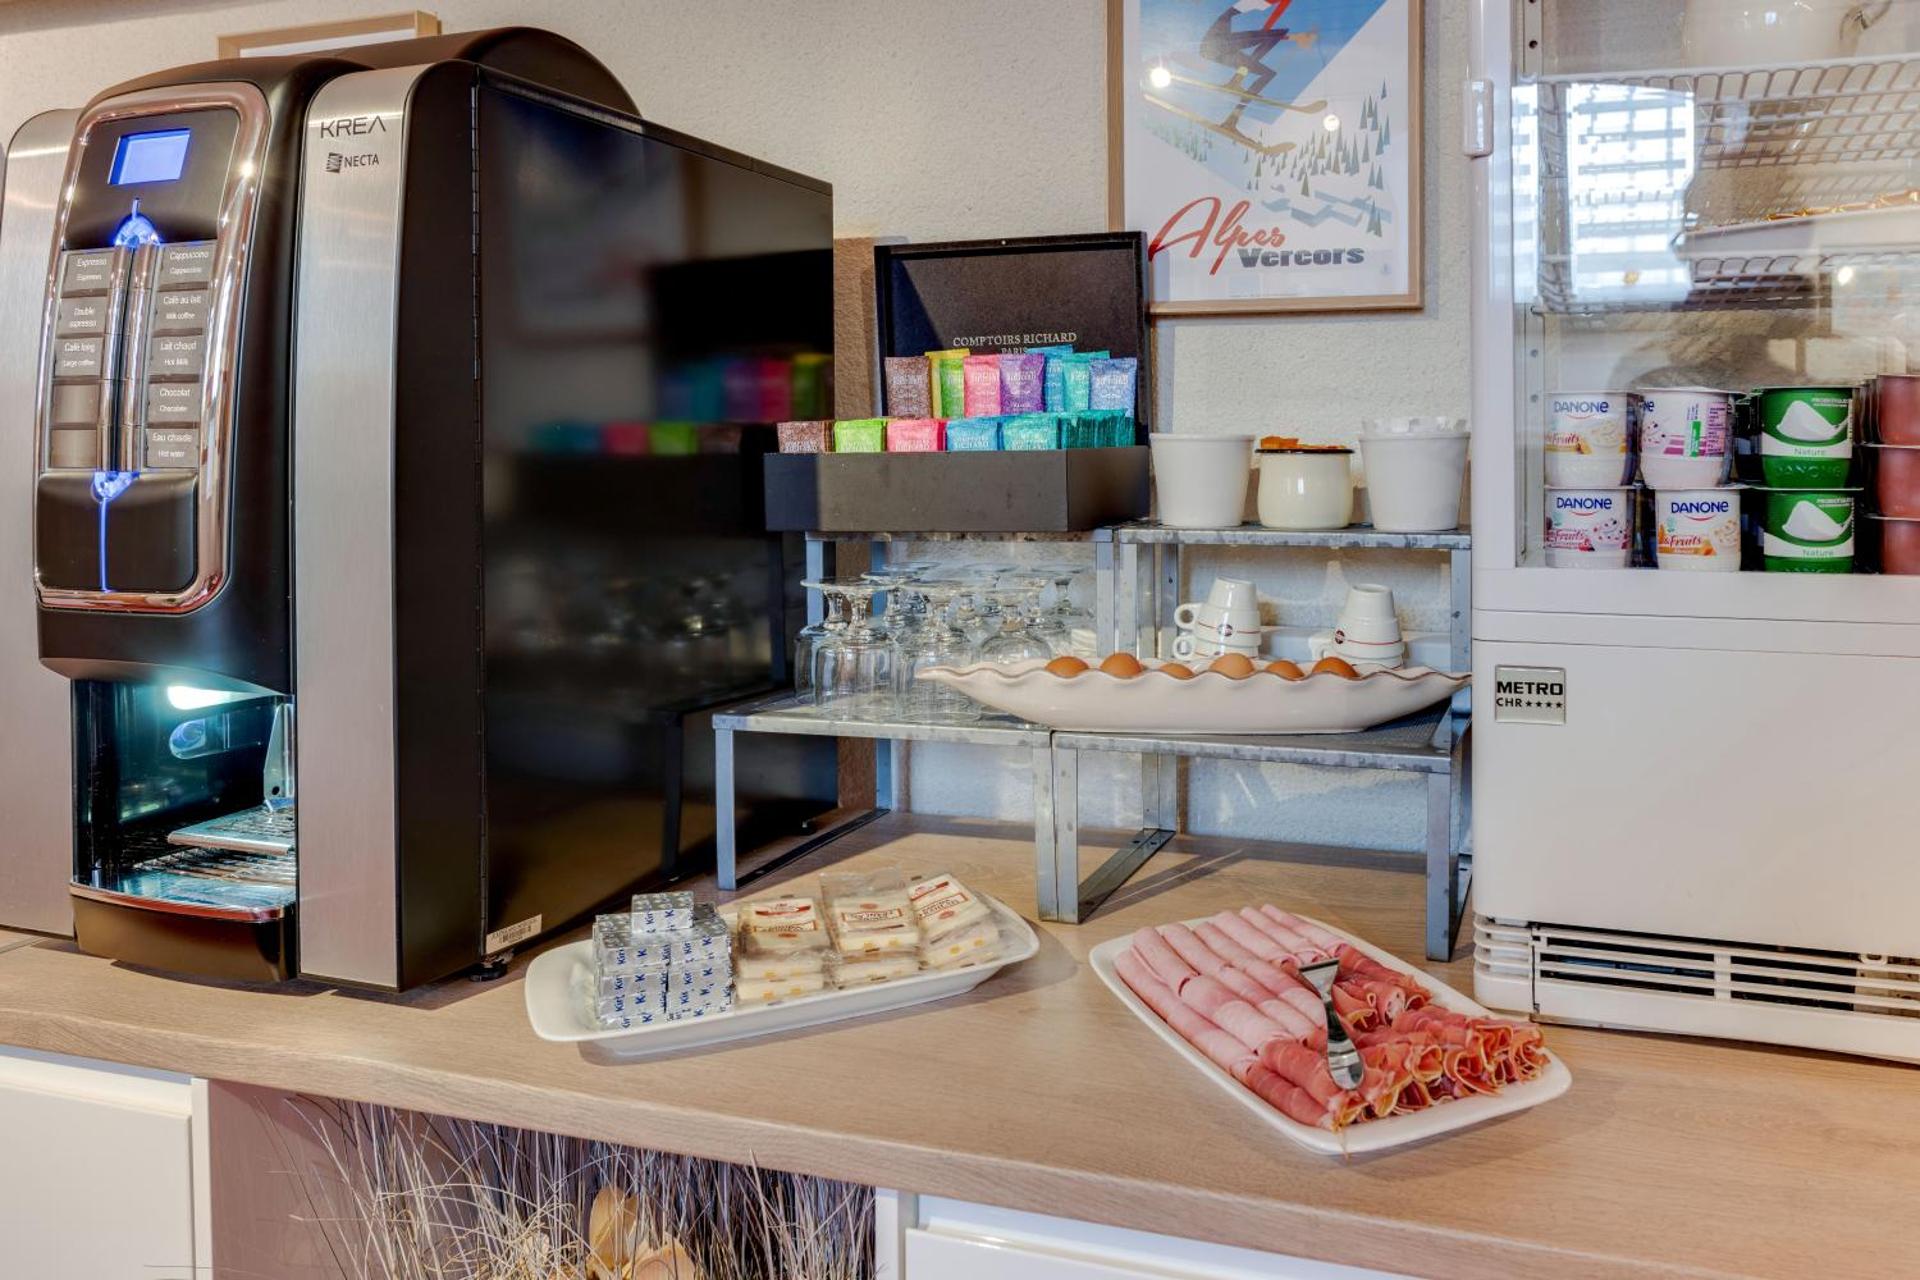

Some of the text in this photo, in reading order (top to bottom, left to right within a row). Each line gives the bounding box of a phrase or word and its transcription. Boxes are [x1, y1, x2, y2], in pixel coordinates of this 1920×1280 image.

[321, 115, 386, 138] KREA
[344, 153, 379, 168] NECTA
[1148, 196, 1286, 275] Alpes
[1239, 247, 1365, 268] Vercors
[953, 332, 1077, 347] COMPTOIRS RICHARD
[1496, 681, 1564, 696] METRO
[1496, 697, 1523, 708] CHR
